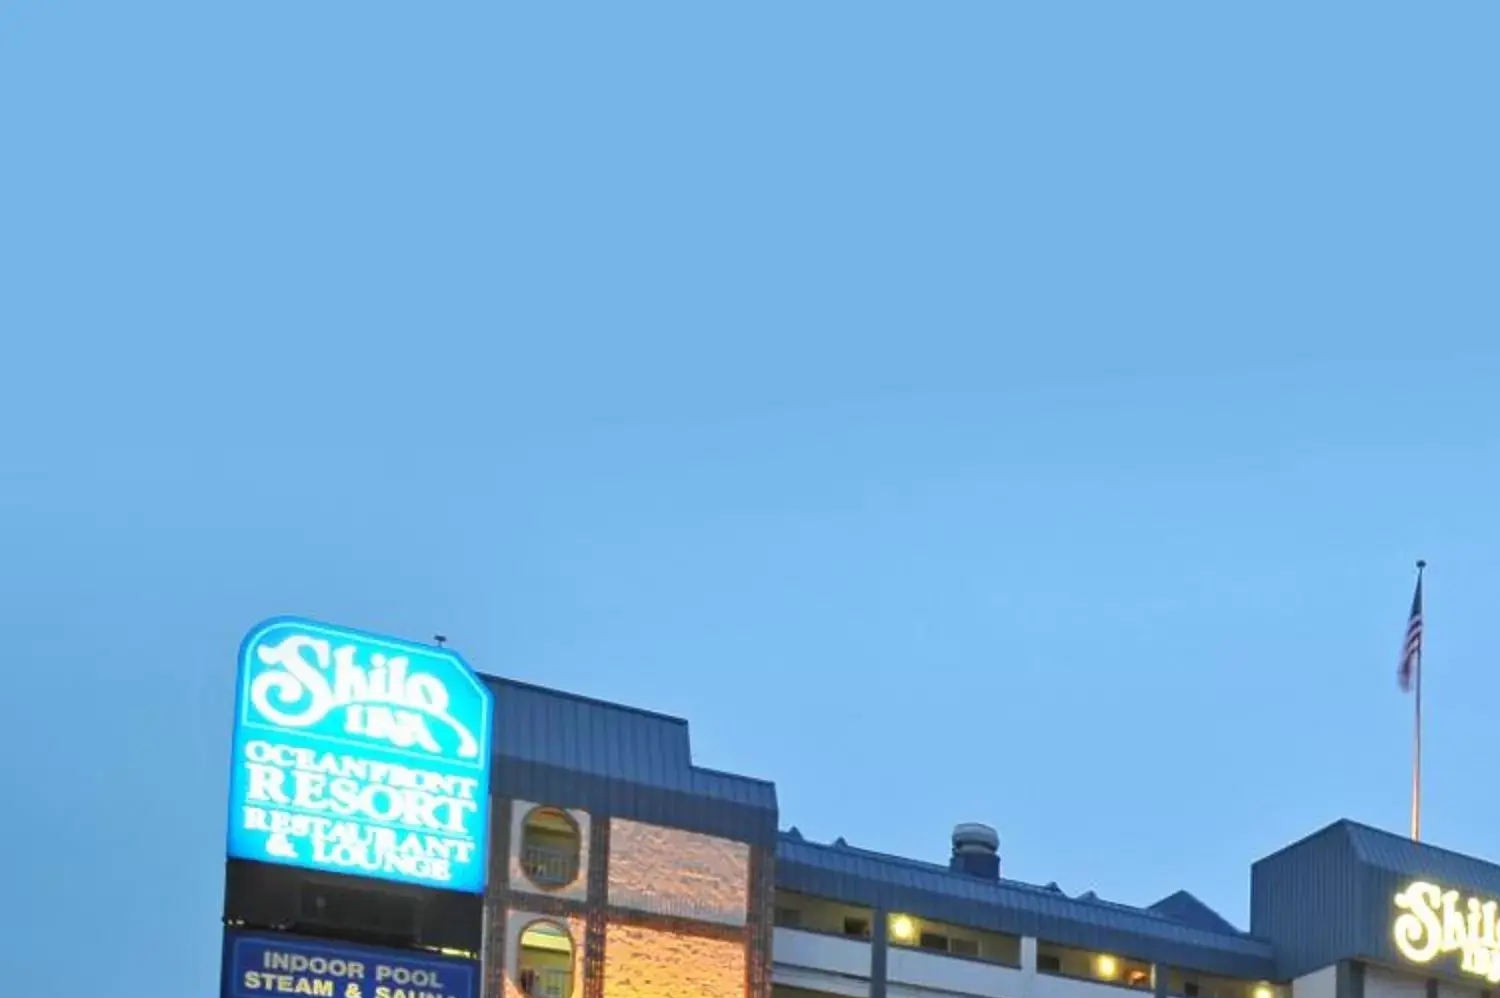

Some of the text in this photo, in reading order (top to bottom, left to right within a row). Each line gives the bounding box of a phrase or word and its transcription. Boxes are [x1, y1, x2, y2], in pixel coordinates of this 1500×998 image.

[251, 635, 478, 757] Shilo
[244, 740, 478, 800] OCEANFRONT
[246, 763, 477, 834] RESORT
[242, 806, 475, 864] RESTAURANT
[265, 831, 453, 881] & LOUNGE
[244, 971, 333, 997] STEAM
[263, 949, 444, 989] INDOOR POOL
